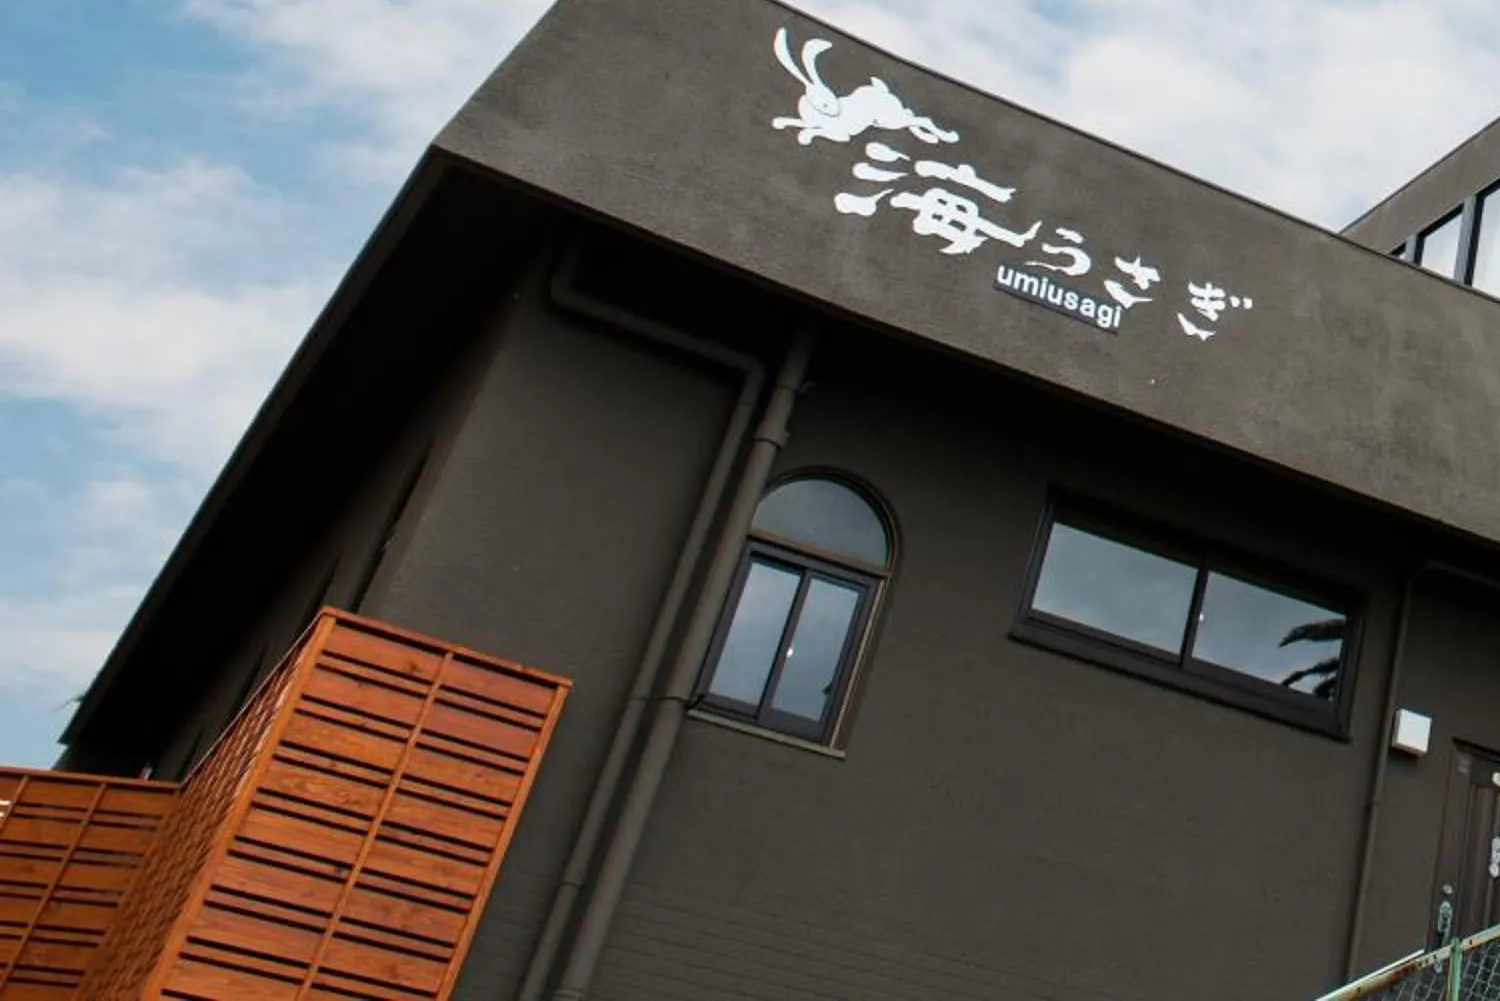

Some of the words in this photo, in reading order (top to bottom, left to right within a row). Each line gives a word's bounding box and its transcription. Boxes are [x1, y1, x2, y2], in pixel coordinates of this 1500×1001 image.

[834, 141, 1253, 340] 海うさぎ
[996, 263, 1124, 328] umiusagi
